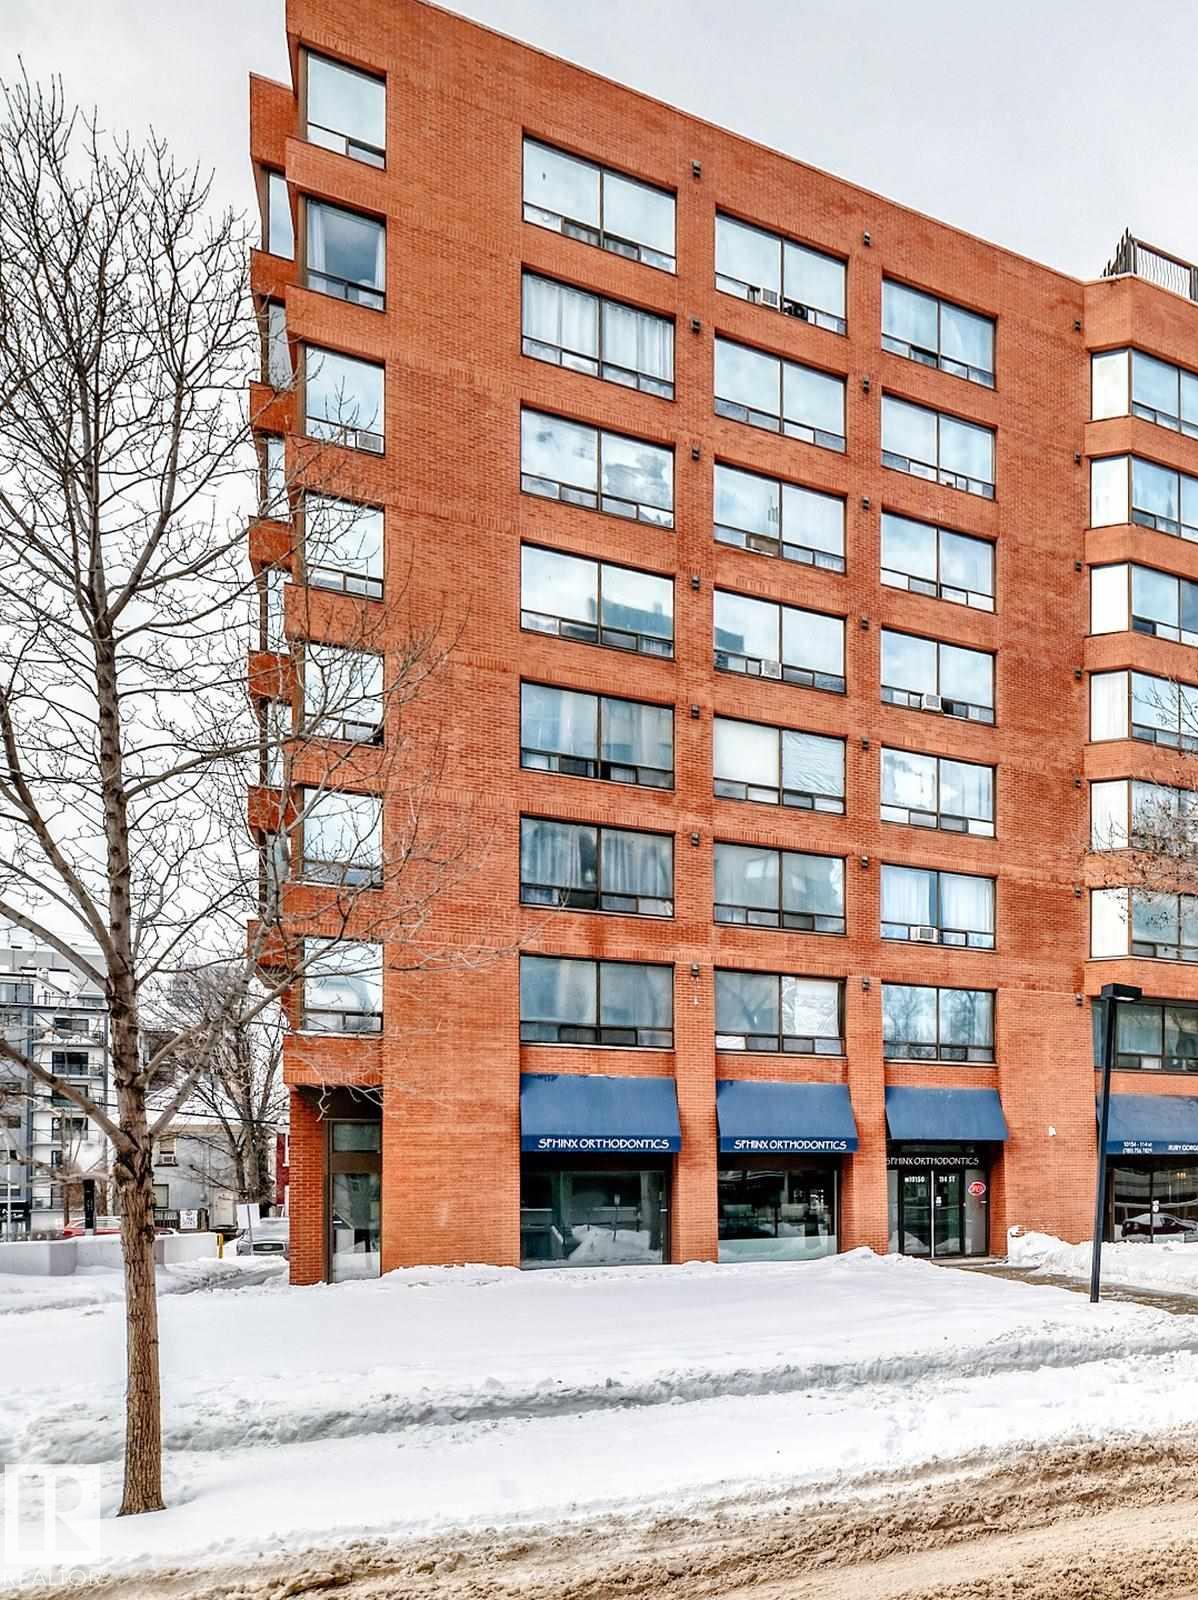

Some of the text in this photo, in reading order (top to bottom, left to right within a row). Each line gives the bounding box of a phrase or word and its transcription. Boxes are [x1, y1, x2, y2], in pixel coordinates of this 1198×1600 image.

[538, 1138, 670, 1149] SPHINX ORTHODONTICS
[734, 1139, 847, 1151] SPHINX ORTHODONTICS
[913, 1156, 979, 1166] ORTHODONTICS
